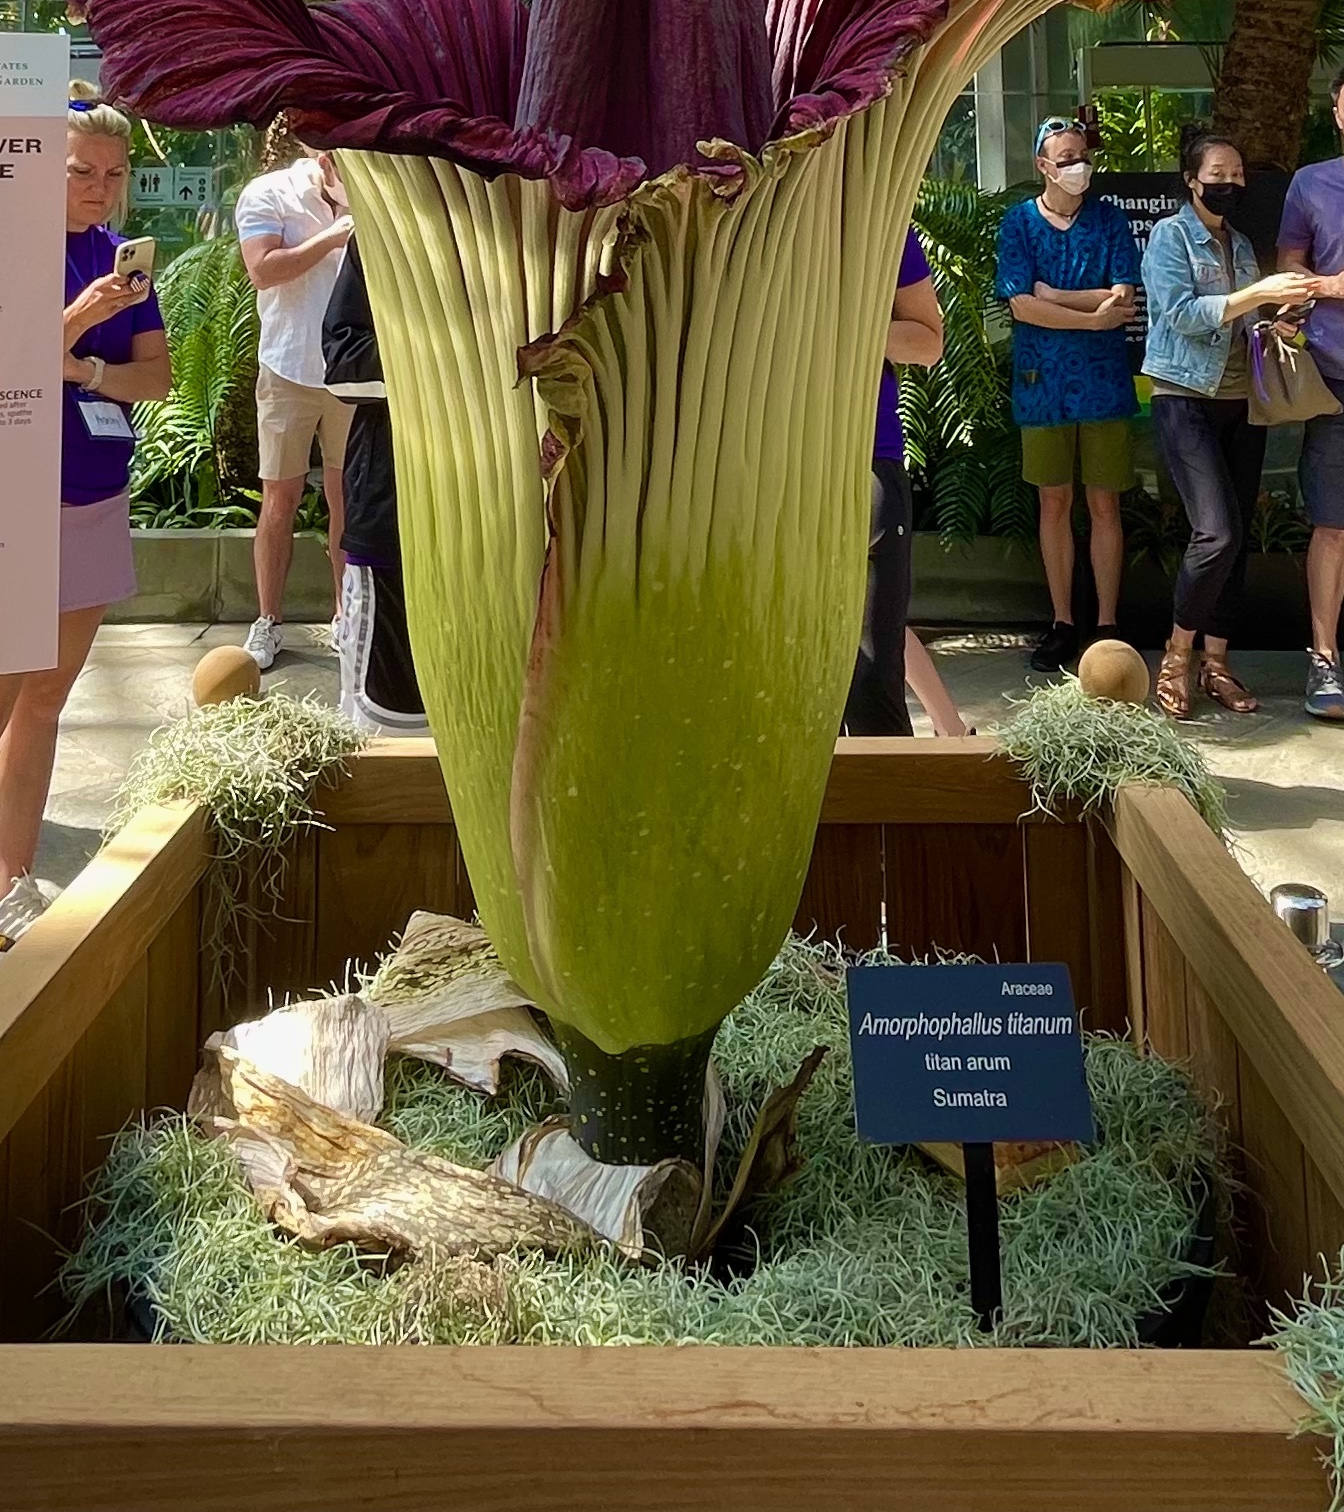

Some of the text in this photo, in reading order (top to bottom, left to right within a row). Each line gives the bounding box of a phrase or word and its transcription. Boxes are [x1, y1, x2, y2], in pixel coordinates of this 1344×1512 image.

[1001, 981, 1054, 996] Araceae
[858, 1012, 1073, 1041] Amorphophallus titanum
[924, 1053, 1012, 1071] titan arum
[933, 1088, 1008, 1108] Sumatra
